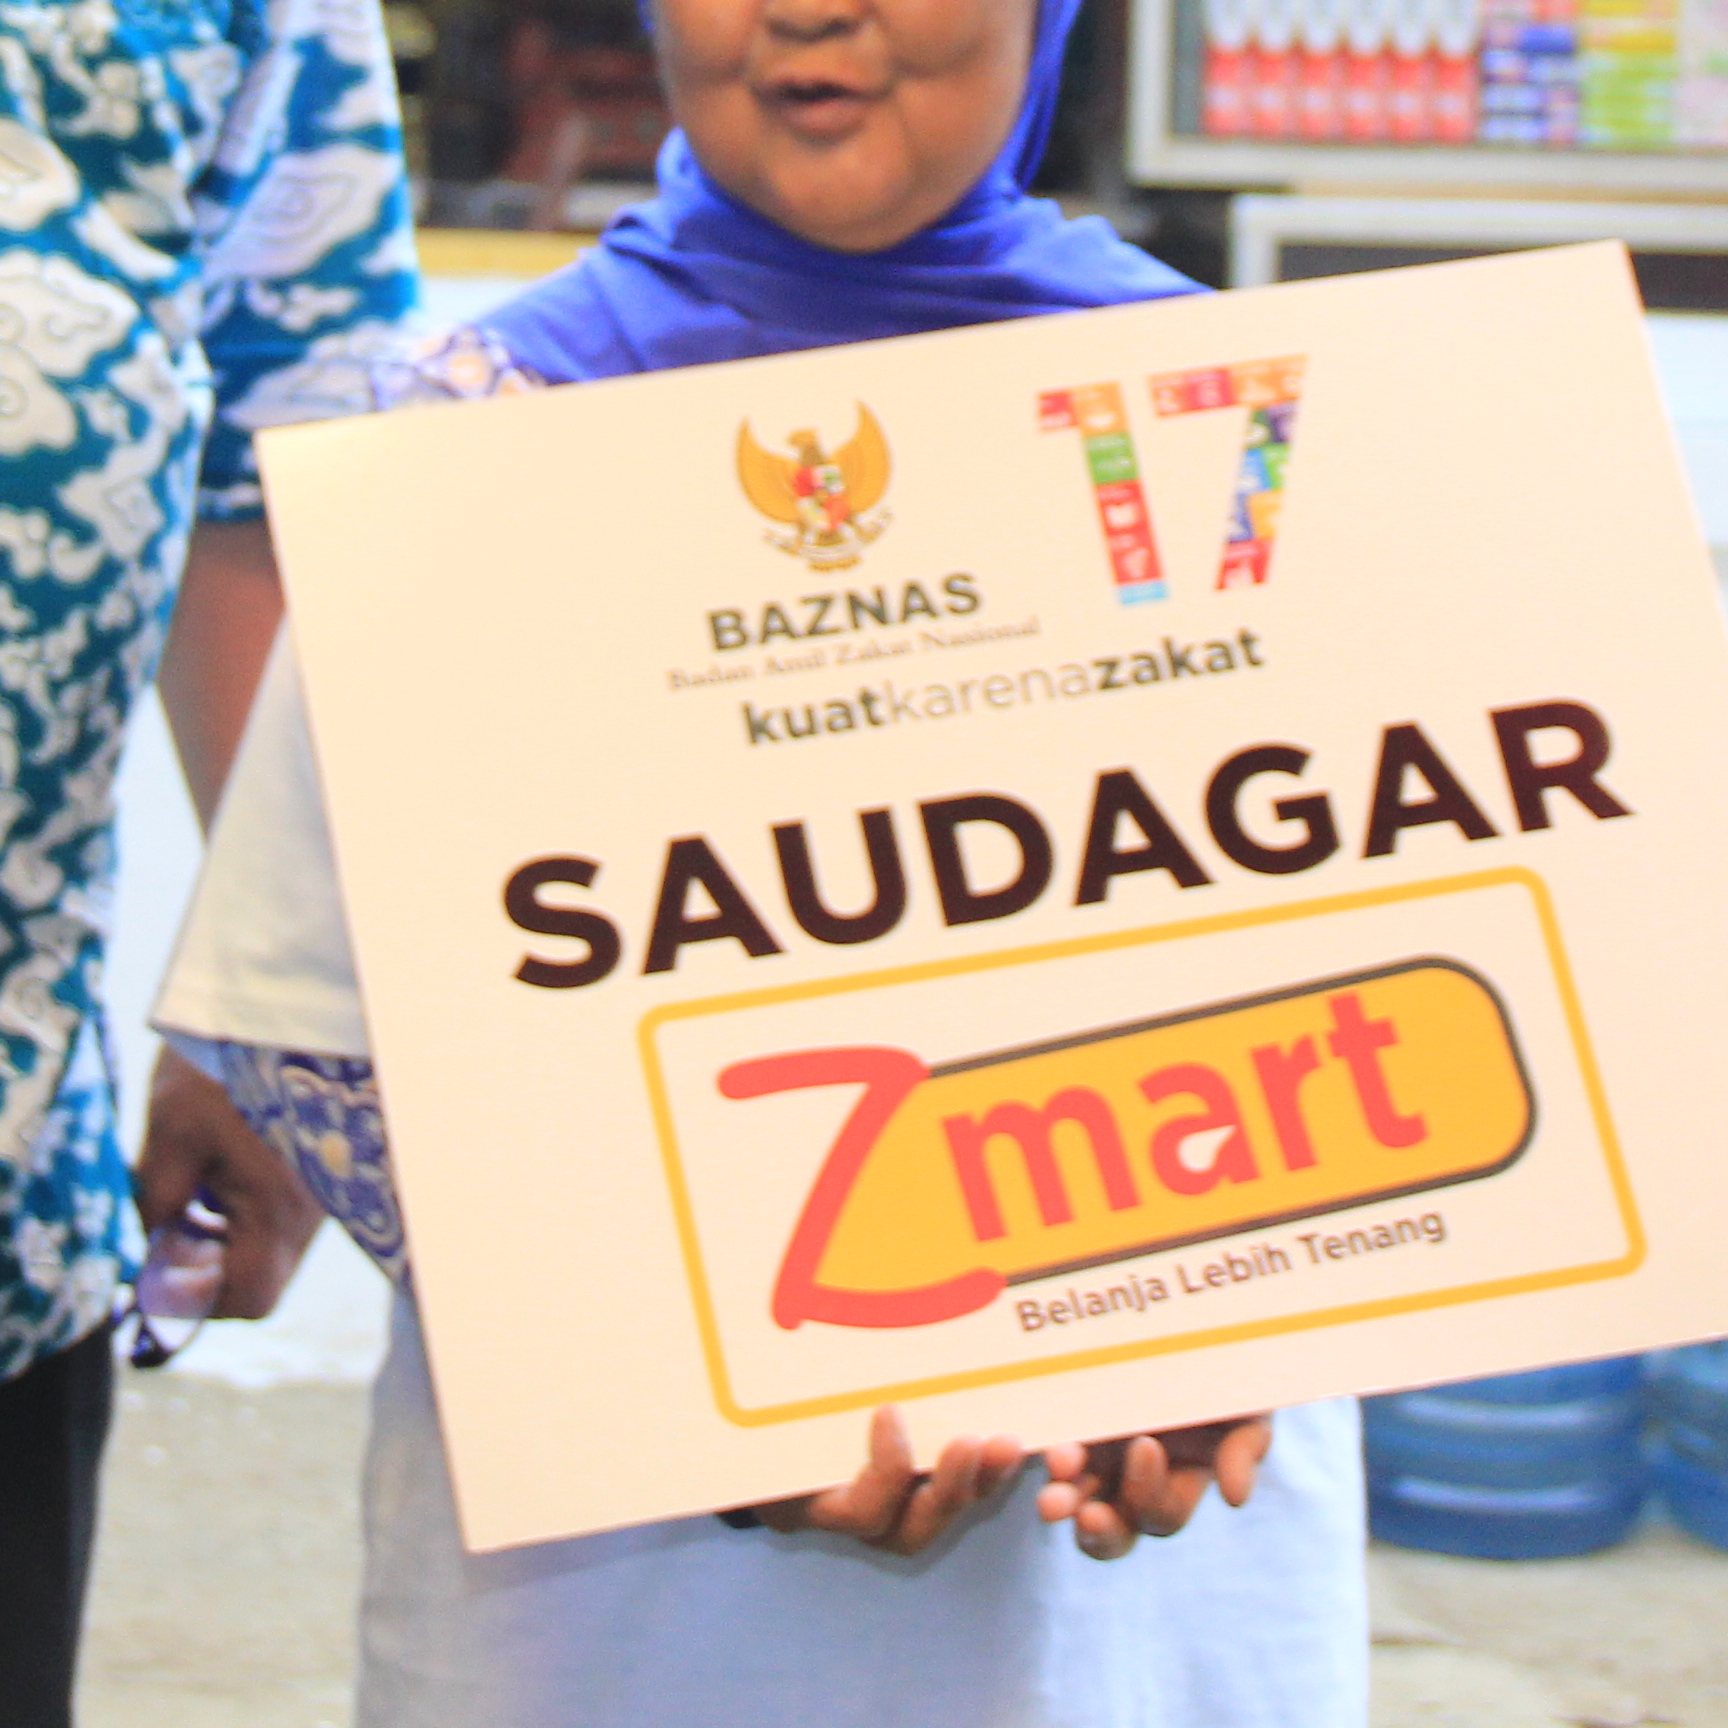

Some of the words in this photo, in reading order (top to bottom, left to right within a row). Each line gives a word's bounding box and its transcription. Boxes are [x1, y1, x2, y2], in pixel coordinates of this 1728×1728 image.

[1035, 352, 1308, 607] 17
[669, 658, 756, 691] Badan
[763, 645, 827, 675] Amil
[836, 634, 911, 667] Zakat
[921, 615, 1041, 653] Nasional
[707, 573, 983, 653] BAZNAS
[741, 627, 1263, 746] kuatkarenazakat
[502, 698, 1634, 989] SAUDAGAR
[716, 990, 1429, 1331] Zmart
[1015, 1274, 1170, 1331] Belanja
[1176, 1243, 1292, 1295] Lebih
[1297, 1211, 1447, 1265] Tenang
